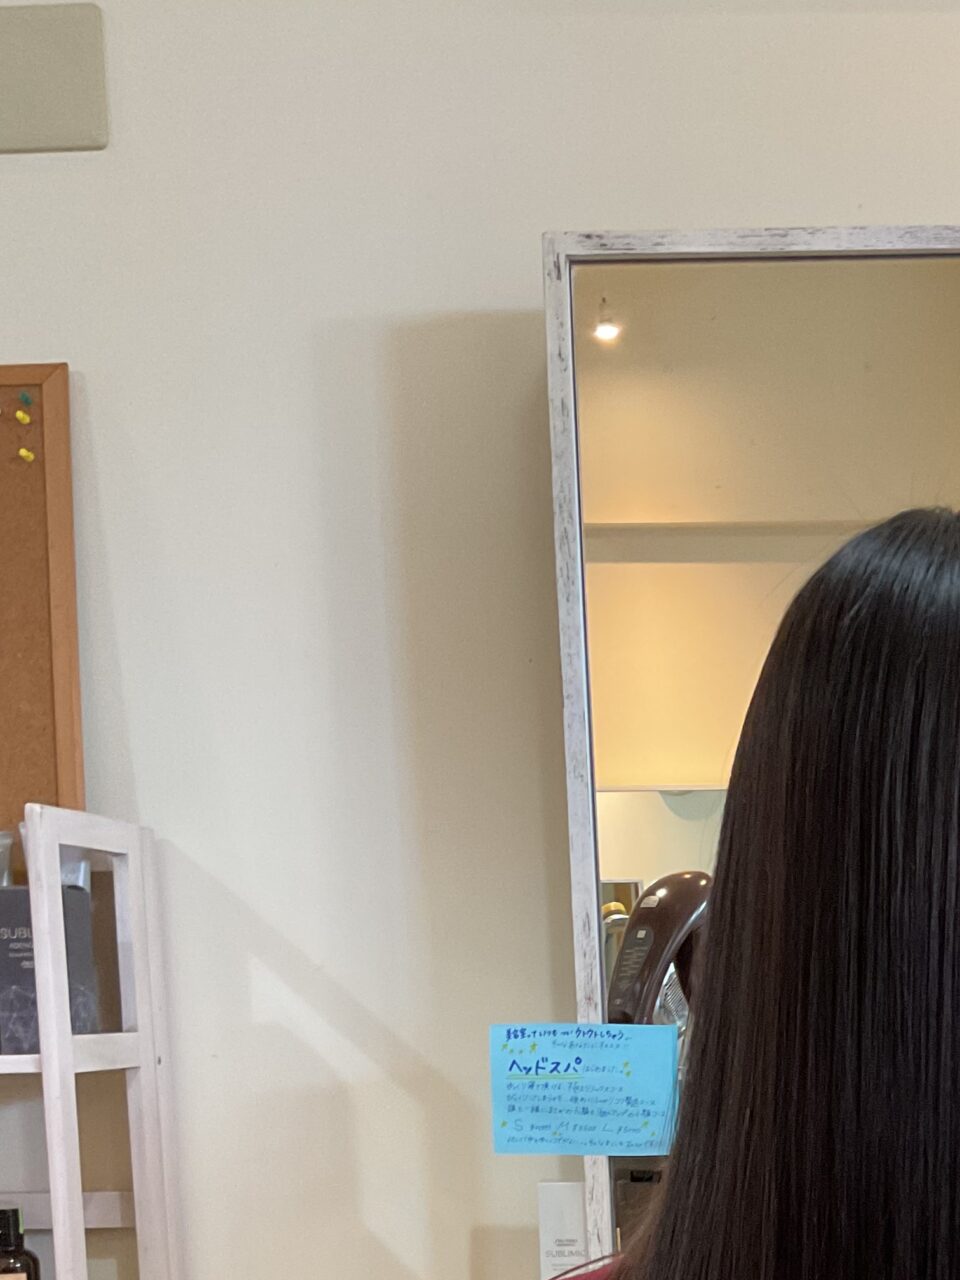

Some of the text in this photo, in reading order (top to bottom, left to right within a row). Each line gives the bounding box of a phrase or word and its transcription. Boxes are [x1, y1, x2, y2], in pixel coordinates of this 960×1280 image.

[509, 1056, 583, 1076] ヘッドスパ
